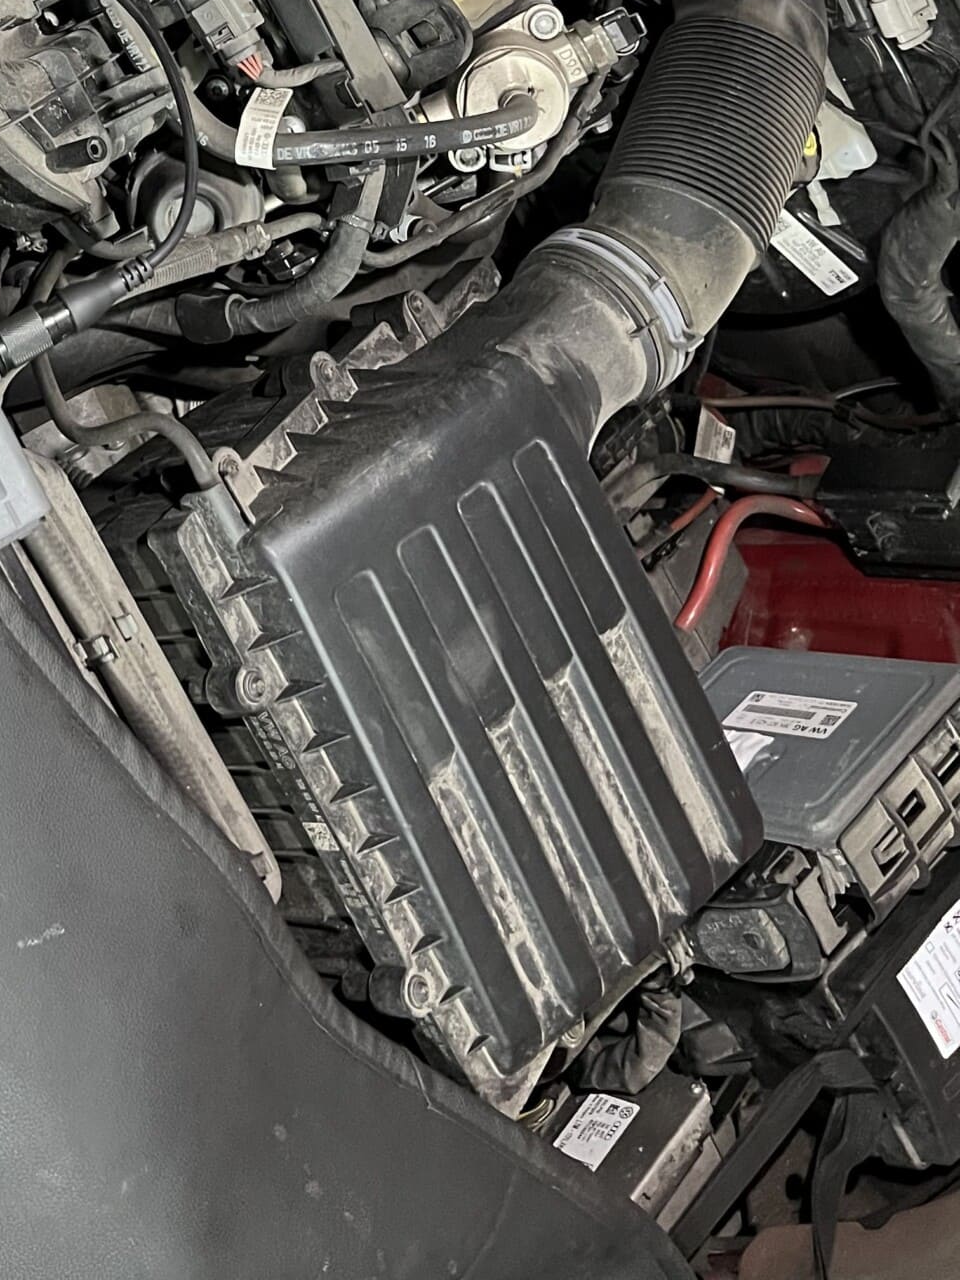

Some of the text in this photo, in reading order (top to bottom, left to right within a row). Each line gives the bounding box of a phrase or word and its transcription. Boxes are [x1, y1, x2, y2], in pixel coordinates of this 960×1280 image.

[424, 135, 437, 149] 16
[792, 723, 809, 731] AG
[808, 726, 827, 734] VW
